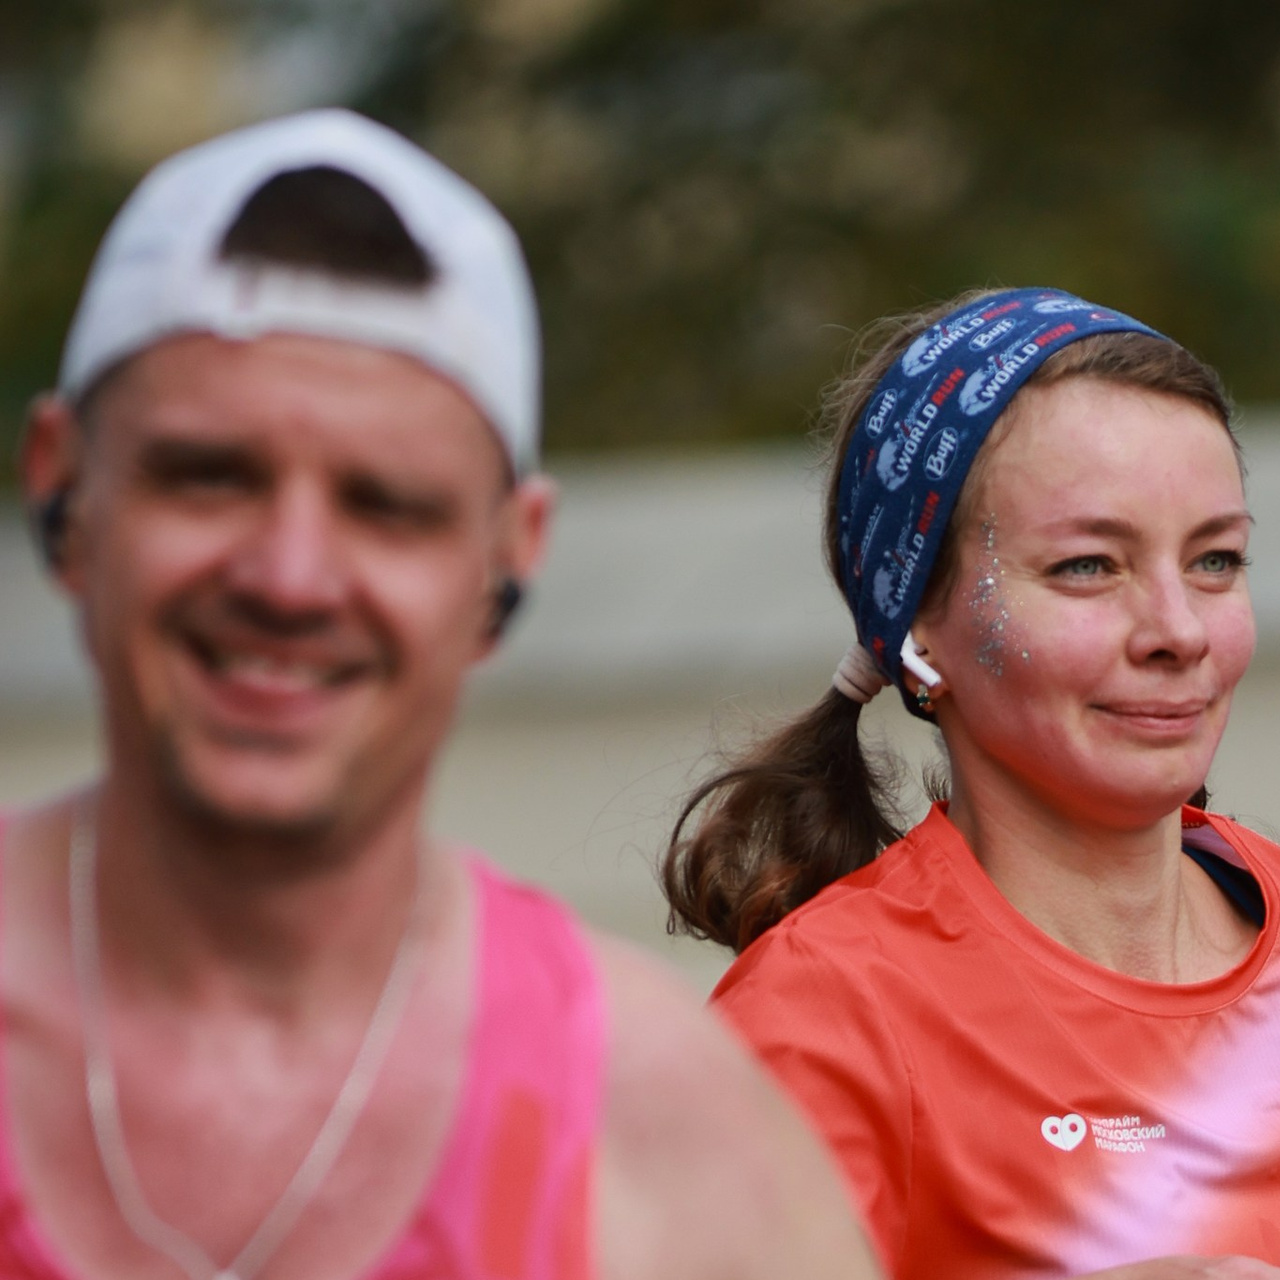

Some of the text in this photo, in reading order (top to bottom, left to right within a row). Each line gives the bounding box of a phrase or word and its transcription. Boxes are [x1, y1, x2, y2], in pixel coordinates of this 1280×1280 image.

[922, 317, 985, 363] WORLD
[981, 342, 1039, 399] WORLD
[896, 403, 938, 472] WORLD
[894, 533, 925, 601] WORLD
